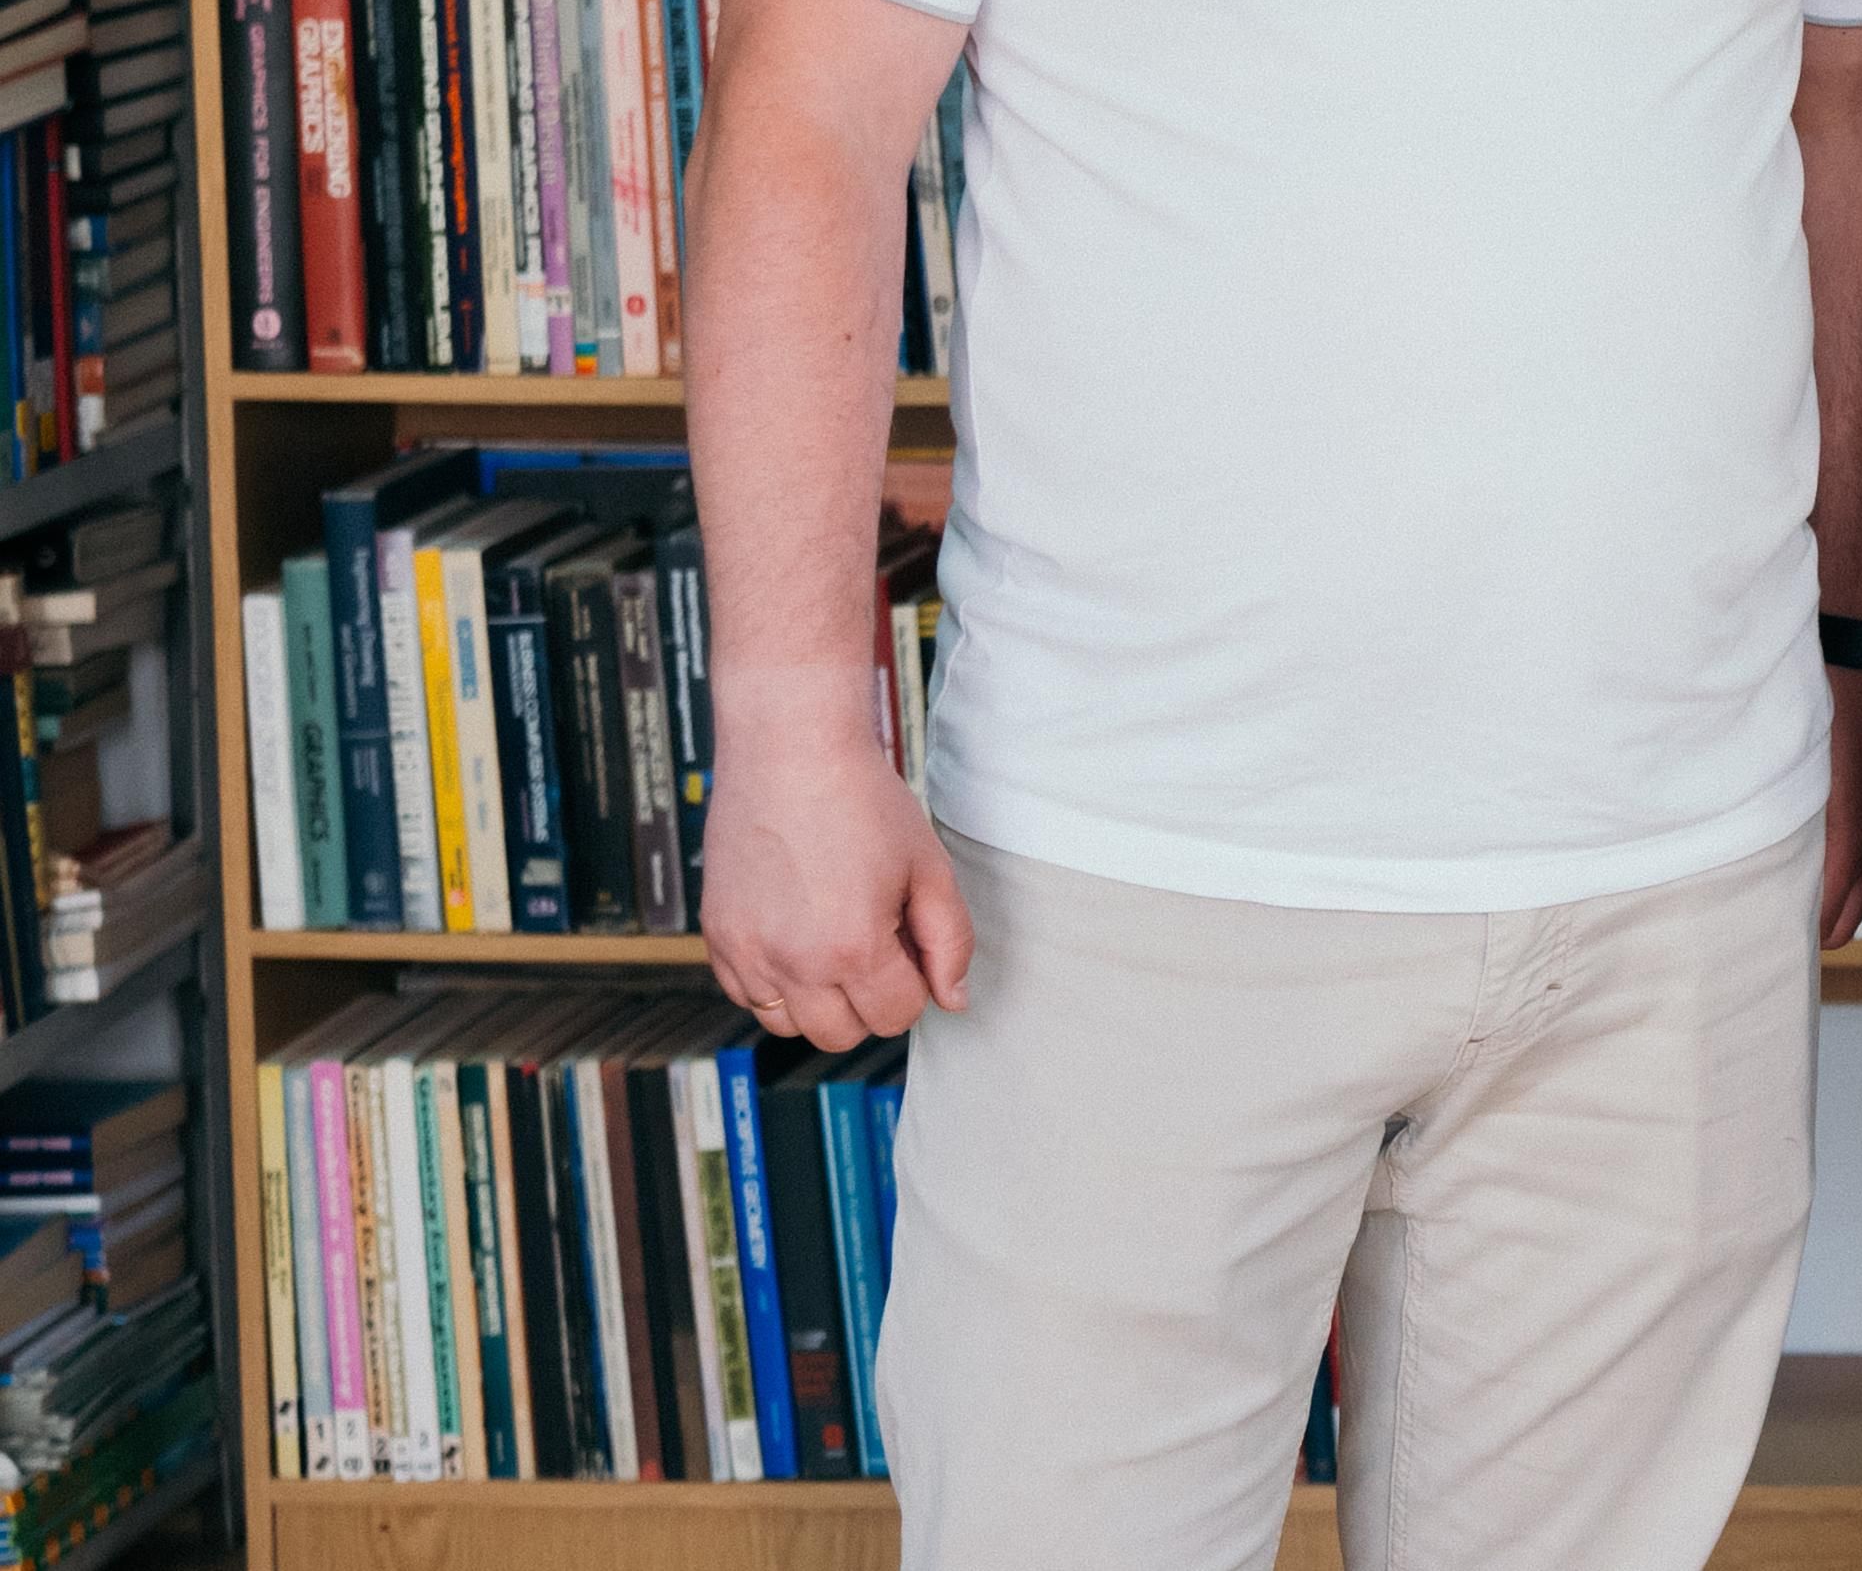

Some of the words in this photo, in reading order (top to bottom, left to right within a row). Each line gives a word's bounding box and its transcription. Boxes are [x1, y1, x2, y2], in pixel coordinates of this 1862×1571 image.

[248, 22, 269, 131] GRAPHICS
[297, 19, 324, 154] GRAPHICS
[322, 19, 351, 199] ENGINEERING
[253, 137, 270, 180] FOR
[254, 186, 274, 304] ENGINEERS
[302, 720, 331, 844] GRAPHICS
[730, 1075, 757, 1175] DESCRIPTIVE
[743, 1179, 767, 1270] GEOMETRY
